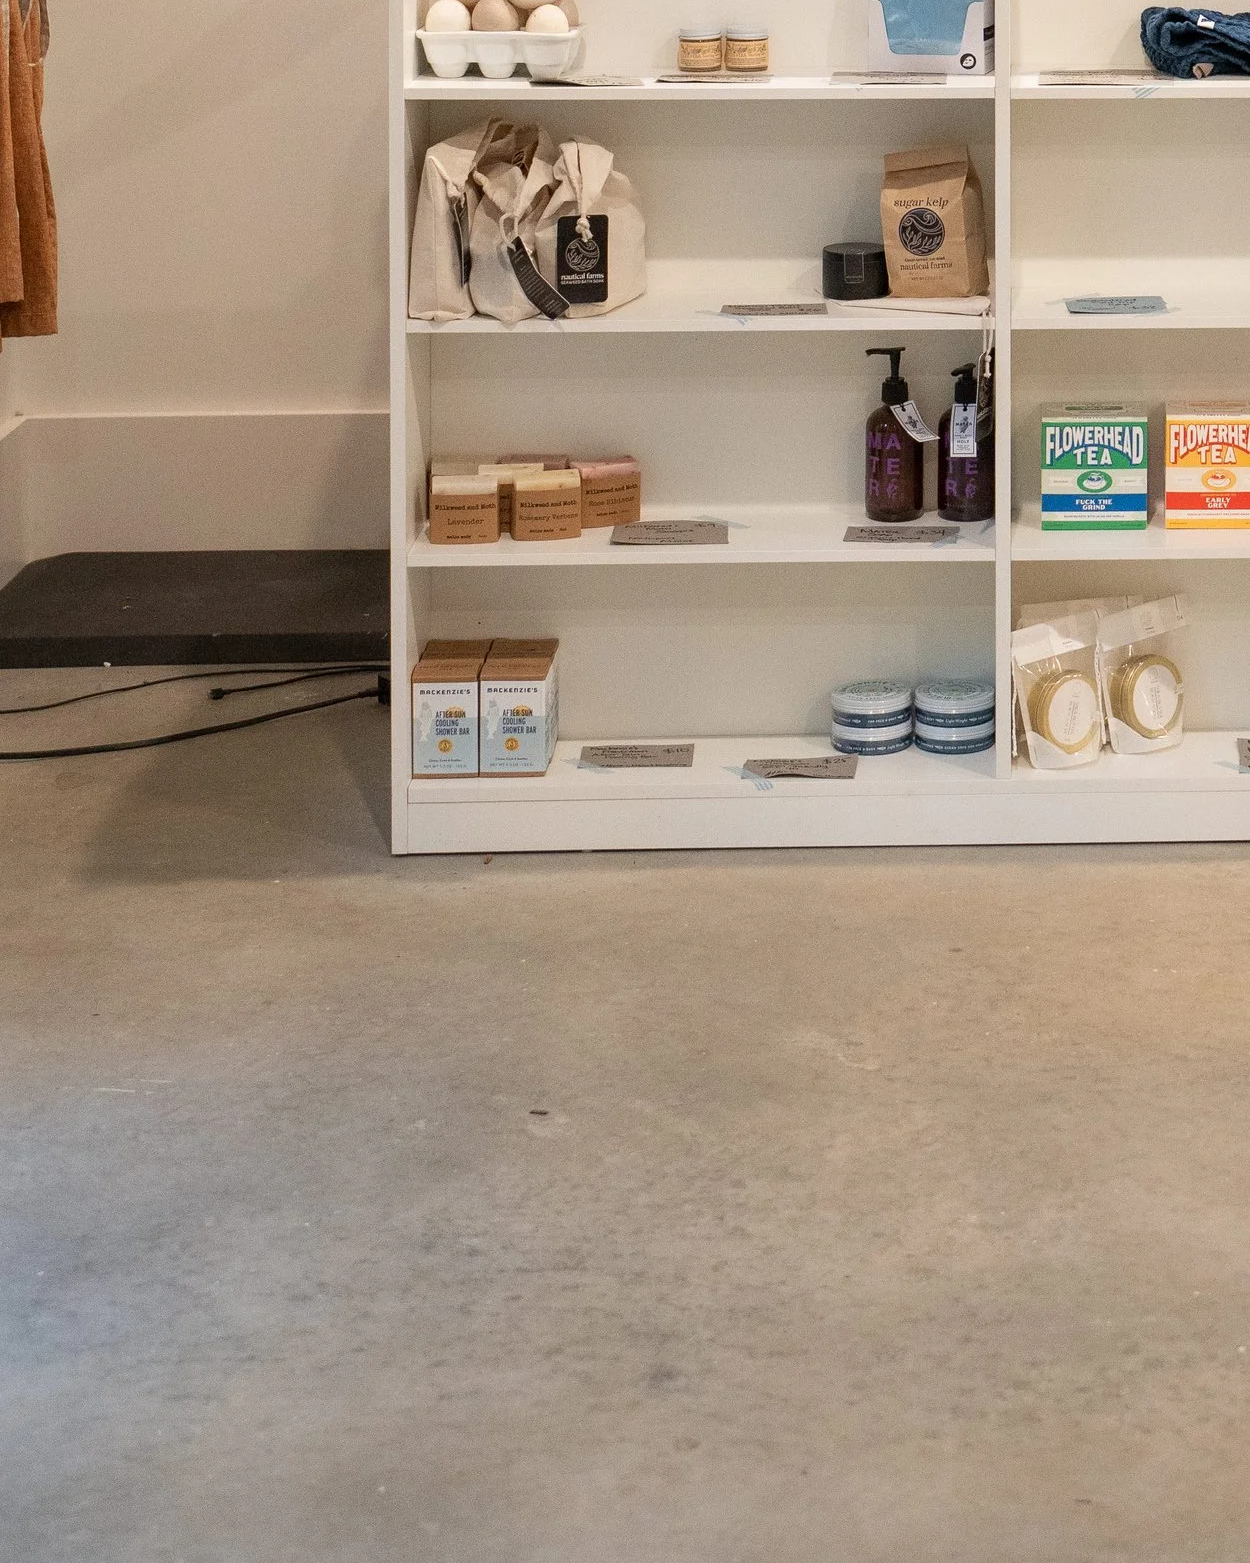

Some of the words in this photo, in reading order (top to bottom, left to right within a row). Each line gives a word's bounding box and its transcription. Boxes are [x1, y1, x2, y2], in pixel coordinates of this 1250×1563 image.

[893, 198, 924, 209] sugar
[926, 197, 949, 209] kelp
[900, 262, 929, 270] nautical
[930, 261, 953, 269] farms
[561, 272, 585, 280] nautical
[1046, 426, 1144, 465] FLOWERHEAD
[1073, 446, 1112, 465] TEA
[1197, 444, 1237, 463] TEA
[585, 487, 614, 495] Milkweed
[520, 501, 550, 509] Milkweed
[564, 499, 577, 507] Moth
[606, 496, 635, 506] Hibiscus
[435, 503, 466, 511] Milkweed
[447, 517, 484, 526] Lavender
[519, 514, 550, 522] Rosemary
[551, 512, 578, 520] Verbena
[455, 710, 466, 718] SUN
[522, 708, 533, 716] SUN
[435, 728, 458, 736] SHOWER
[502, 726, 524, 734] SHOWER
